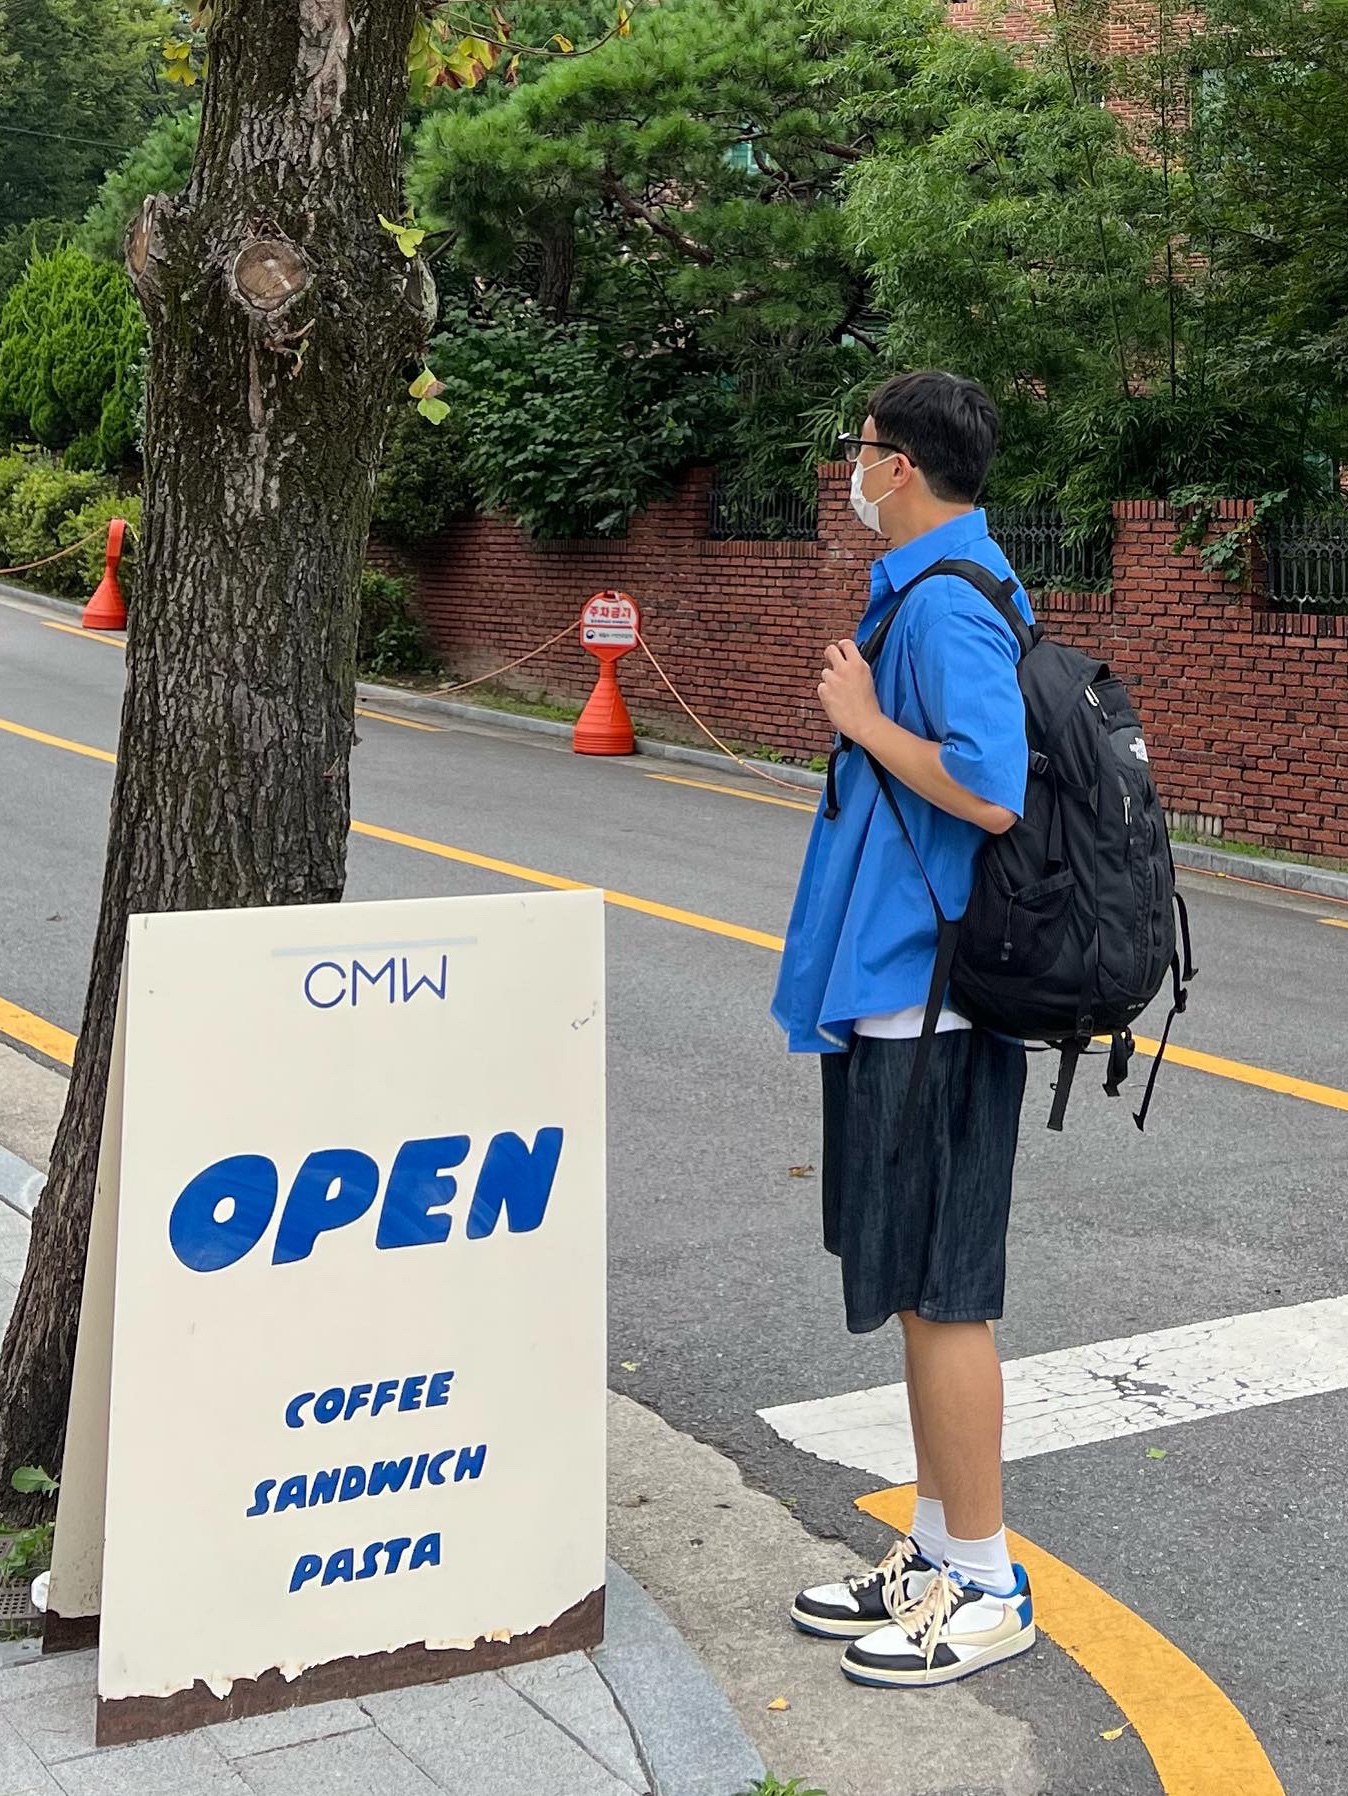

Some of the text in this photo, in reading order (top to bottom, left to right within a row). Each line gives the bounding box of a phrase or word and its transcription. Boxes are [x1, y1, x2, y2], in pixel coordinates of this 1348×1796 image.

[589, 606, 632, 619] 주차금지
[304, 954, 447, 1008] CMW
[168, 1126, 564, 1273] OPEN
[285, 1370, 455, 1429] COFFEE
[246, 1443, 487, 1517] SANDWICH
[289, 1531, 441, 1592] PASTA
